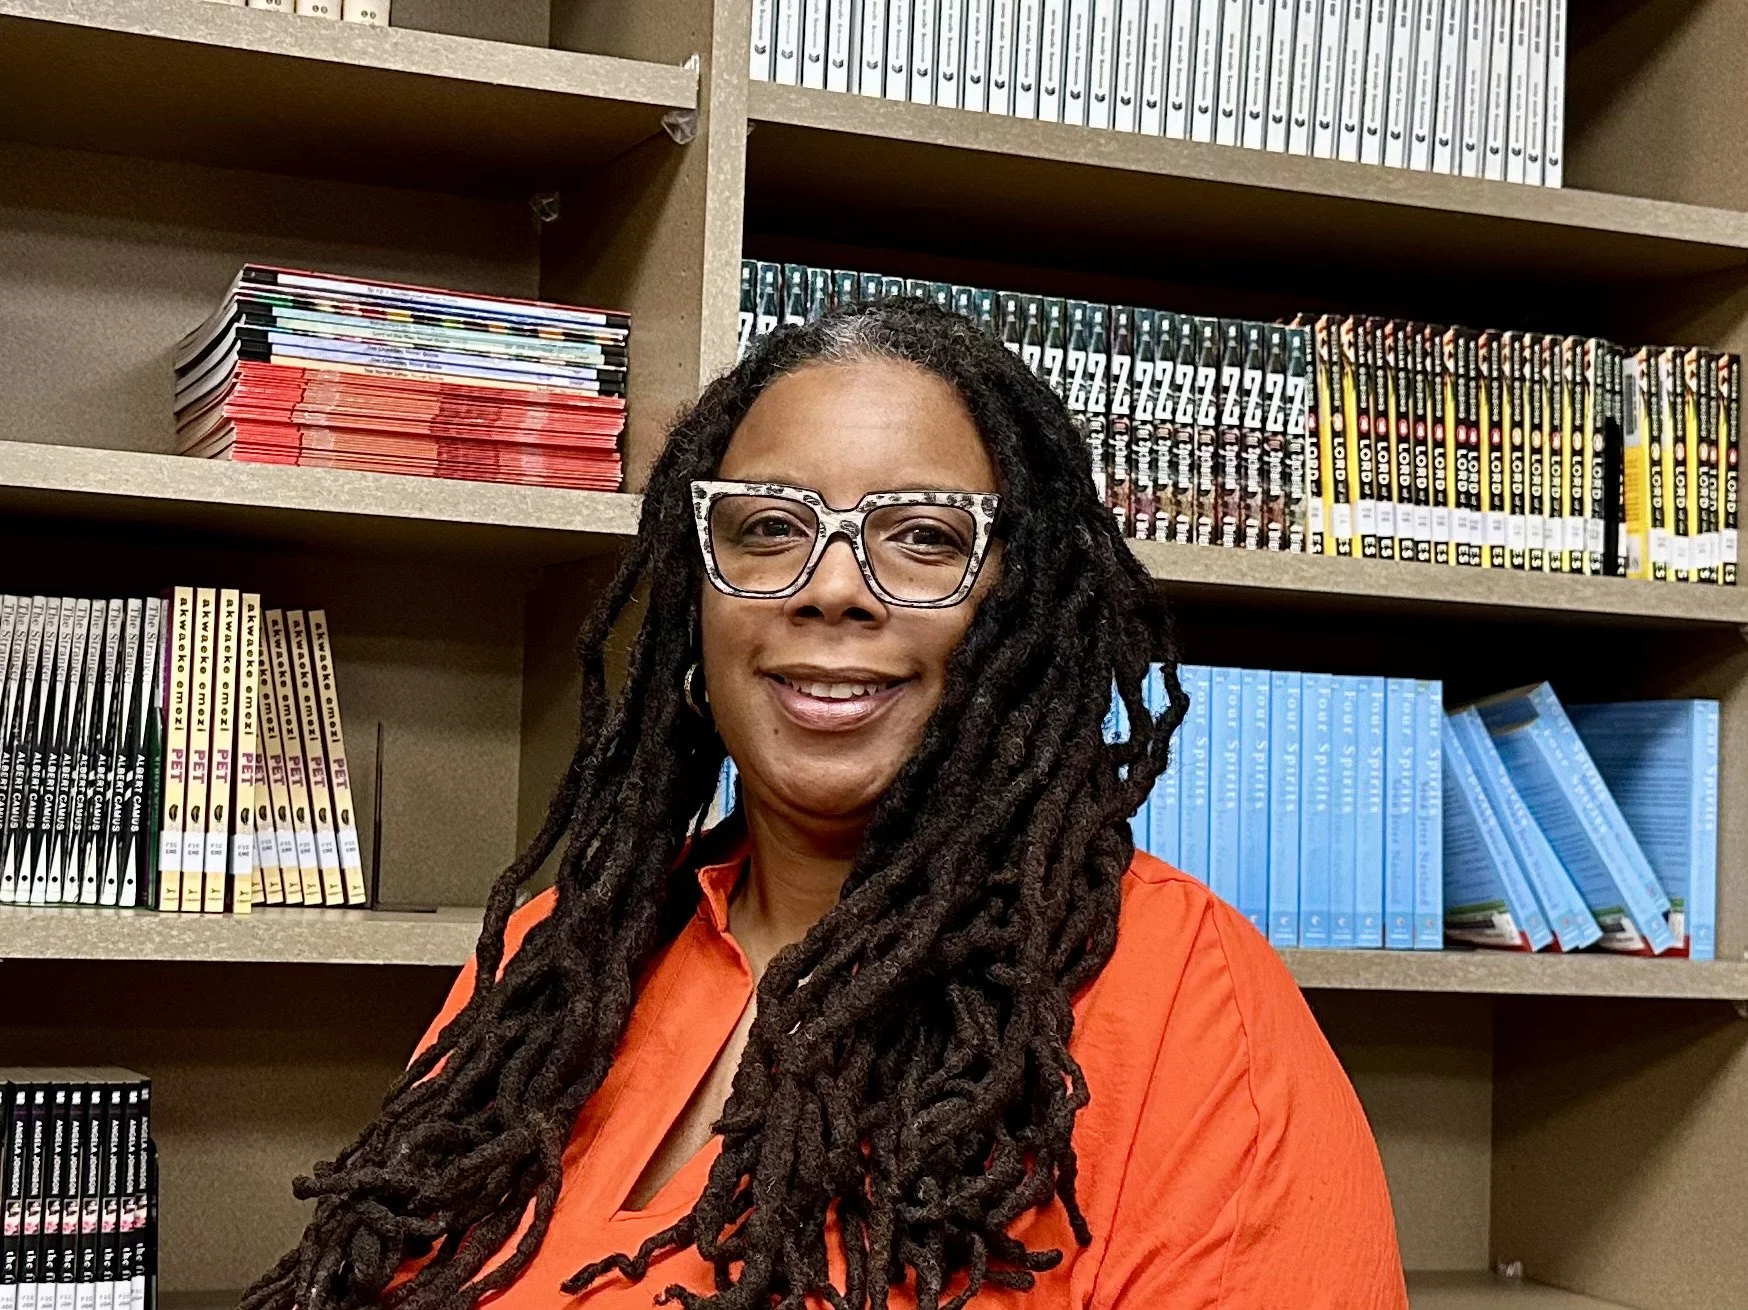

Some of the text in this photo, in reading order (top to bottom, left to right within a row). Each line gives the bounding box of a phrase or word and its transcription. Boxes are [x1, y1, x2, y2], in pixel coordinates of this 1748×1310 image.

[1334, 438, 1346, 480] LORD
[1360, 440, 1372, 482] LORD
[1377, 442, 1389, 484] LORD
[1399, 443, 1410, 486] LORD
[1416, 446, 1427, 488] LORD
[1434, 448, 1445, 490] LORD
[1457, 449, 1468, 492] LORD
[1468, 452, 1478, 494] LORD
[1491, 452, 1501, 494] LORD
[1512, 452, 1522, 494] LORD
[1532, 454, 1541, 496] LORD
[1551, 456, 1560, 498] LORD
[1572, 456, 1582, 498] LORD
[1592, 458, 1602, 499] LORD
[1652, 466, 1662, 508] LORD
[1676, 466, 1685, 508] LORD
[1700, 466, 1709, 509] LORD
[1727, 471, 1737, 513] LORD
[3, 604, 14, 626] The
[17, 603, 29, 625] The
[32, 604, 44, 625] The
[47, 605, 58, 627] The
[62, 606, 74, 629] The
[76, 606, 87, 629] The
[93, 607, 104, 629] The
[110, 607, 121, 628] The
[130, 607, 141, 629] The
[148, 605, 159, 628] The
[175, 597, 189, 731] akwaeke emezi
[197, 599, 211, 732] akwaeke emezi
[220, 599, 235, 731] akwaeke emezi
[245, 604, 256, 735] akwaeke emezi
[272, 619, 296, 740] akwaeke emezi
[293, 621, 318, 741] akwaeke emezi
[315, 623, 340, 742] akwaeke emezi
[263, 693, 277, 739] emezi
[1193, 681, 1208, 805] Four Spirits
[1224, 685, 1240, 809] Four Spirits
[1252, 685, 1268, 809] Four Spirits
[1283, 688, 1299, 811] Four Spirits
[1314, 689, 1331, 811] Four Spirits
[1341, 691, 1356, 813] Four Spirits
[1368, 692, 1383, 813] Four Spirits
[1399, 693, 1414, 813] Four Spirits
[1426, 695, 1441, 815] Four Spirits
[0, 752, 10, 790] ALBERT
[171, 749, 183, 783] PET
[193, 750, 206, 784] PET
[216, 749, 229, 783] PET
[242, 752, 254, 786] PET
[270, 754, 284, 785] PET
[289, 756, 302, 787] PET
[311, 757, 325, 788] PET
[333, 758, 347, 789] PET
[10, 752, 25, 829] ALBERT CAMUS
[26, 752, 42, 829] ALBERT CAMUS
[42, 752, 57, 830] ALBERT CAMUS
[56, 753, 71, 830] ALBERT CAMUS
[74, 754, 88, 830] ALBERT CAMUS
[92, 754, 106, 831] ALBERT CAMUS
[112, 755, 126, 832] ALBERT CAMUS
[131, 754, 145, 832] ALBERT CAMUS
[6, 1252, 16, 1270] the
[26, 1251, 36, 1269] the
[46, 1249, 57, 1268] the
[64, 1250, 74, 1269] the
[84, 1249, 94, 1268] the
[104, 1248, 114, 1267] the
[122, 1248, 132, 1266] the
[136, 1243, 145, 1261] the
